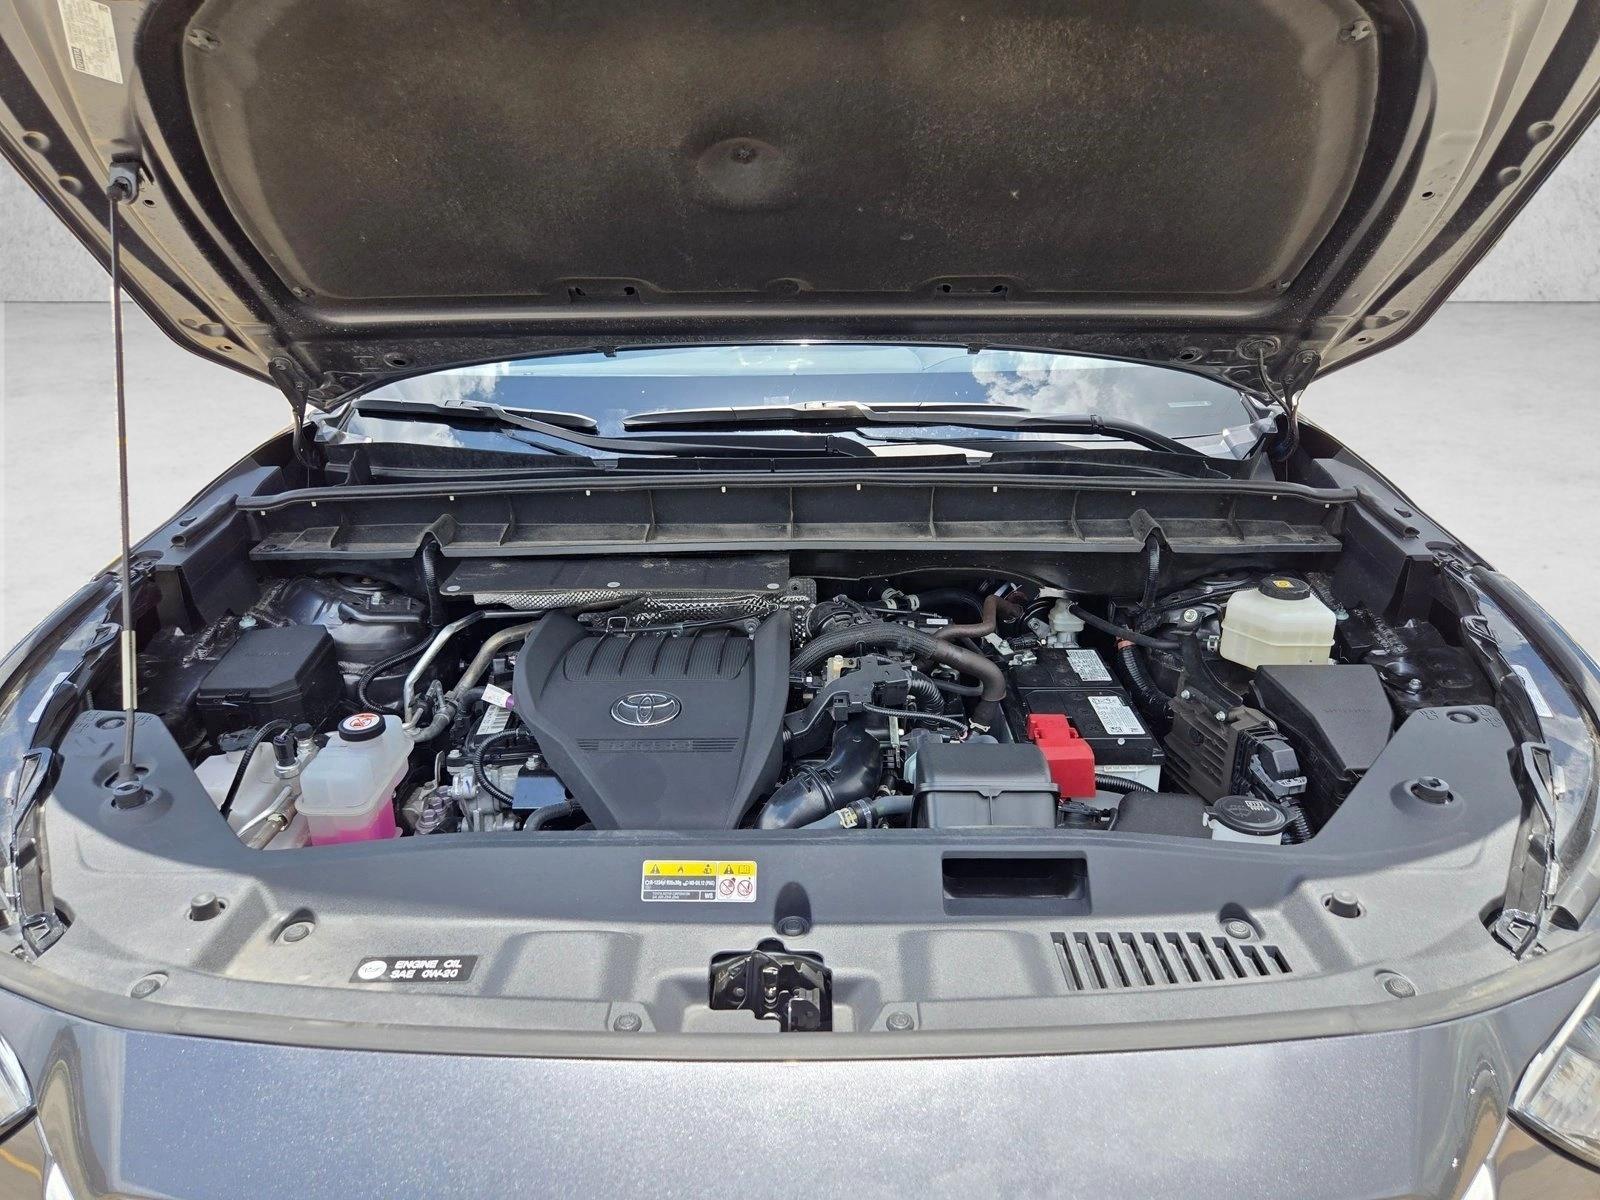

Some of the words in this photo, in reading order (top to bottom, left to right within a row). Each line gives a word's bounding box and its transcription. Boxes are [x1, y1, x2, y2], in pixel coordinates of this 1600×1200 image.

[395, 960, 439, 969] ENGINE
[443, 960, 462, 968] OIL
[390, 969, 416, 978] SAE
[421, 969, 459, 978] 0W-20
